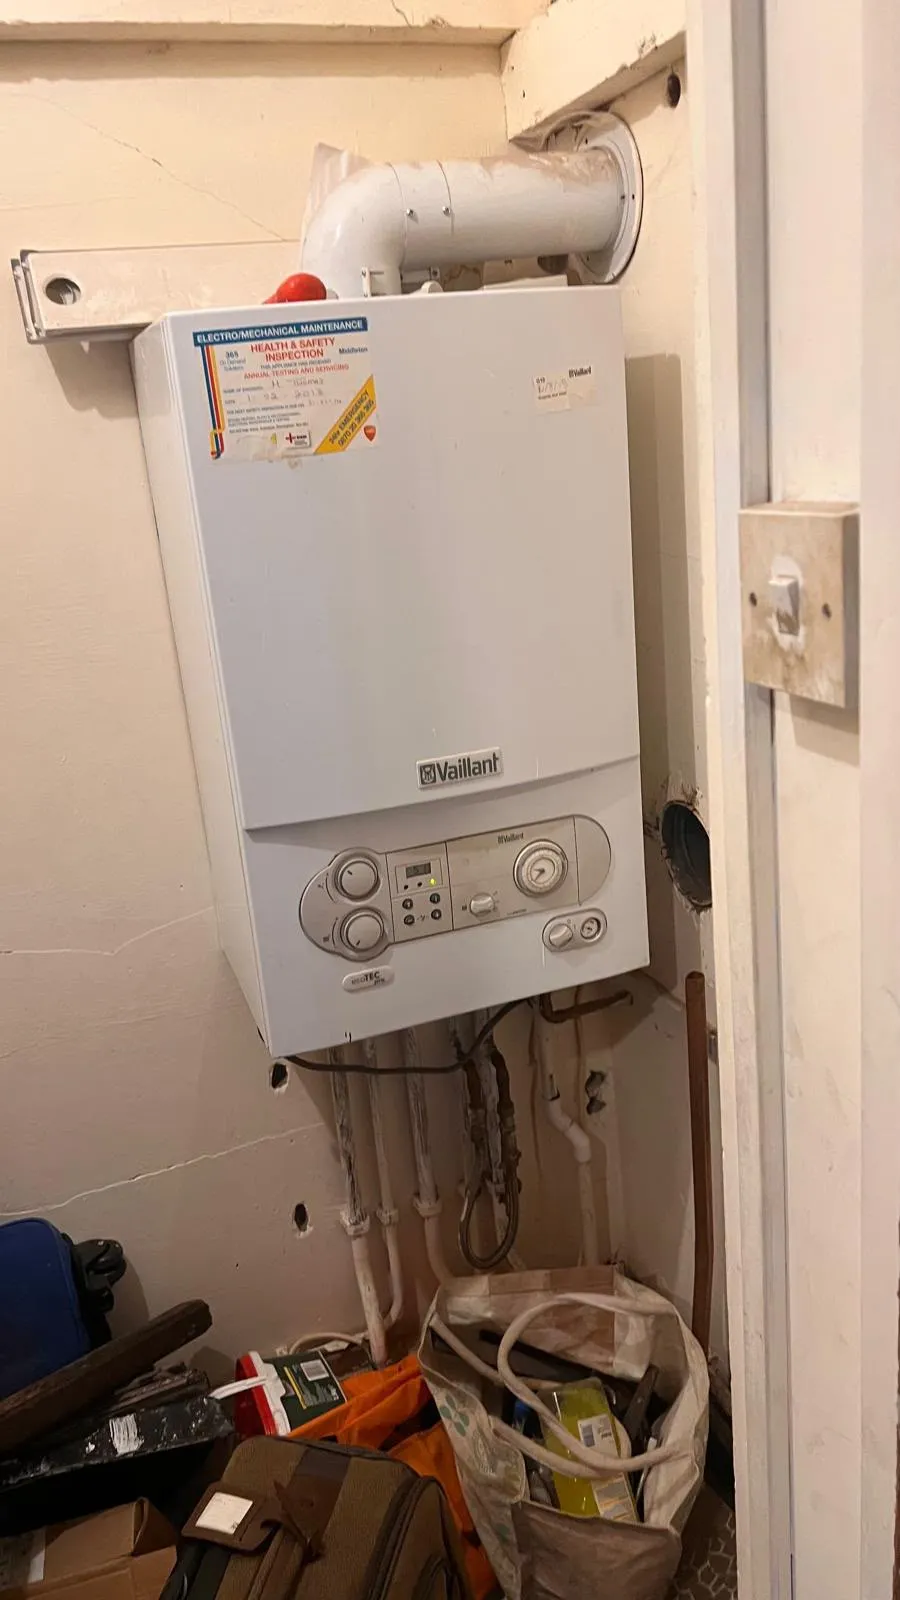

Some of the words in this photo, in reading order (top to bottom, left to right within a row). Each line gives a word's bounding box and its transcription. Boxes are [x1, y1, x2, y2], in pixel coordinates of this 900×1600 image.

[197, 326, 298, 343] ELECTRO/MECHANICAL
[300, 320, 362, 333] MAINTENANCE
[251, 341, 288, 352] HEALTH
[291, 340, 298, 349] &
[300, 336, 335, 349] SAFETY
[265, 348, 324, 362] INSPECTION
[244, 370, 270, 379] ANNUAL
[271, 367, 300, 377] TESTING
[301, 365, 314, 374] AND
[315, 362, 350, 373] SERVICING
[435, 751, 500, 781] Vaillant
[503, 832, 524, 843] Vaillant
